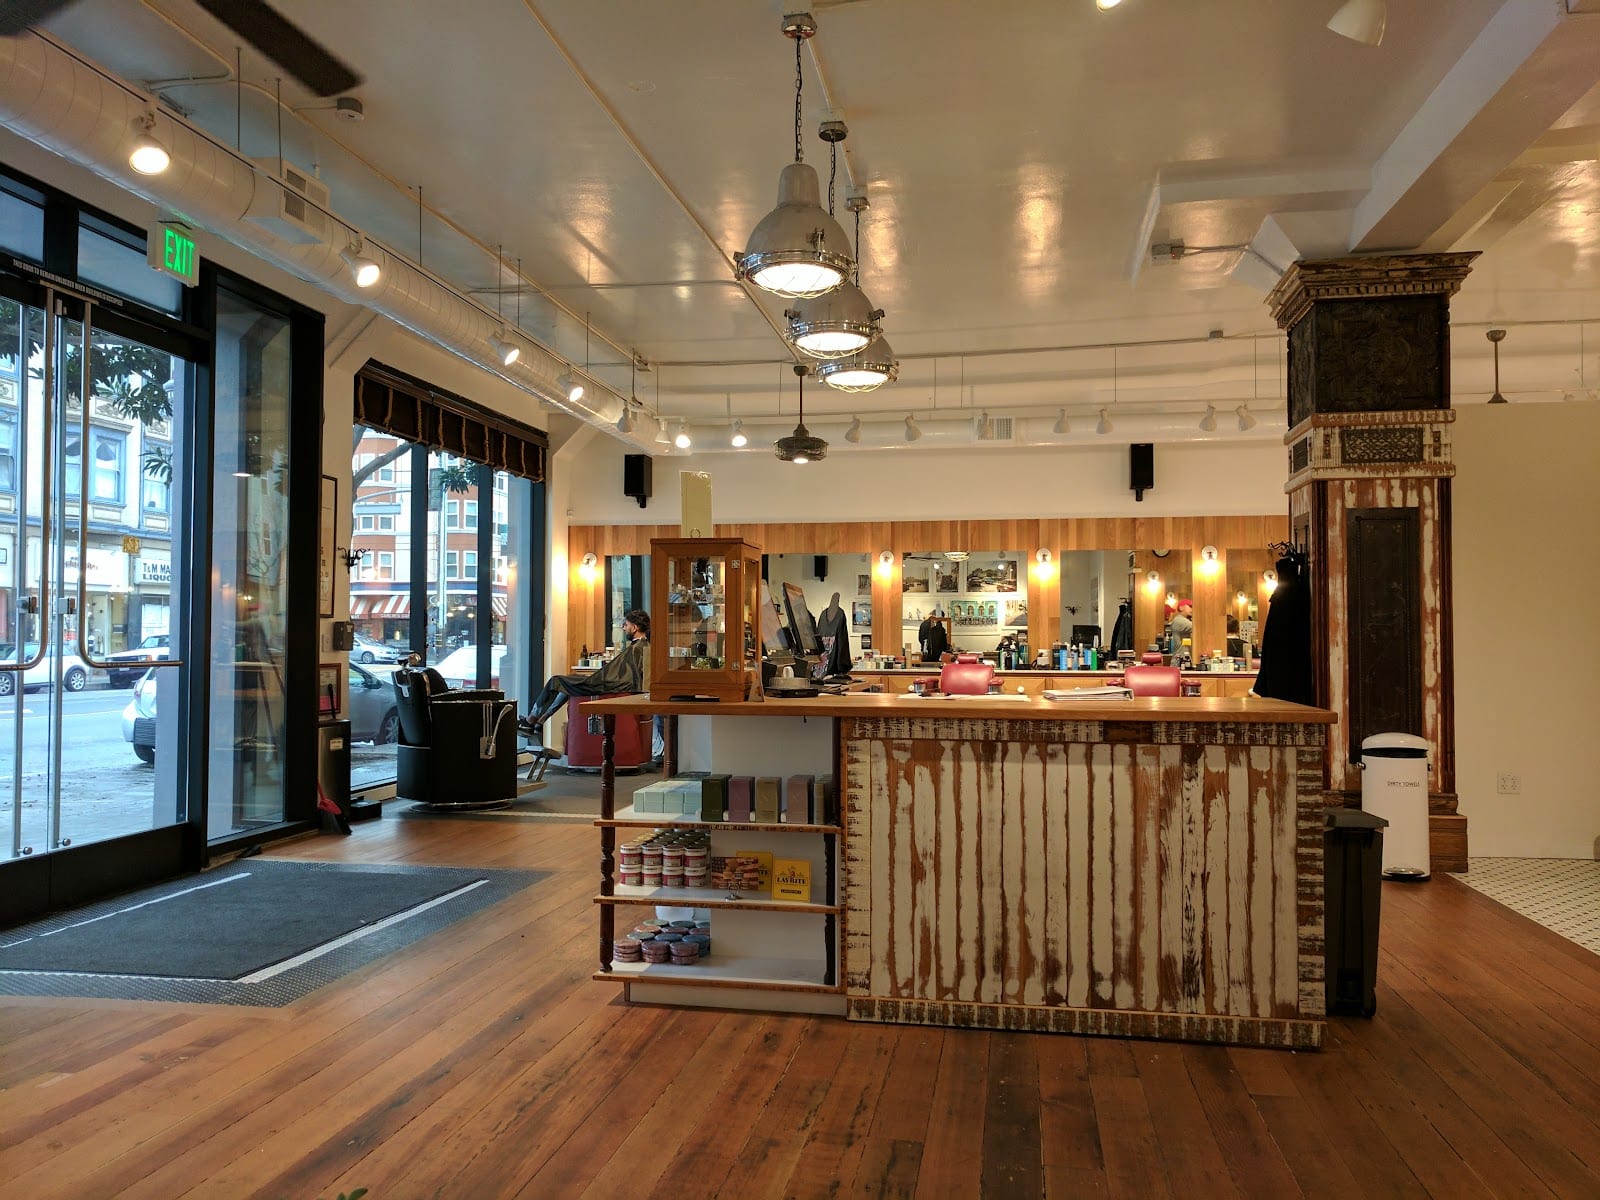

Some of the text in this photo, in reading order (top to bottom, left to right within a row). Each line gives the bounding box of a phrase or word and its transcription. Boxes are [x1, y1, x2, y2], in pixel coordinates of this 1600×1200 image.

[164, 228, 195, 278] EXIT
[143, 562, 171, 574] T&M MA
[143, 573, 171, 581] LIQUO
